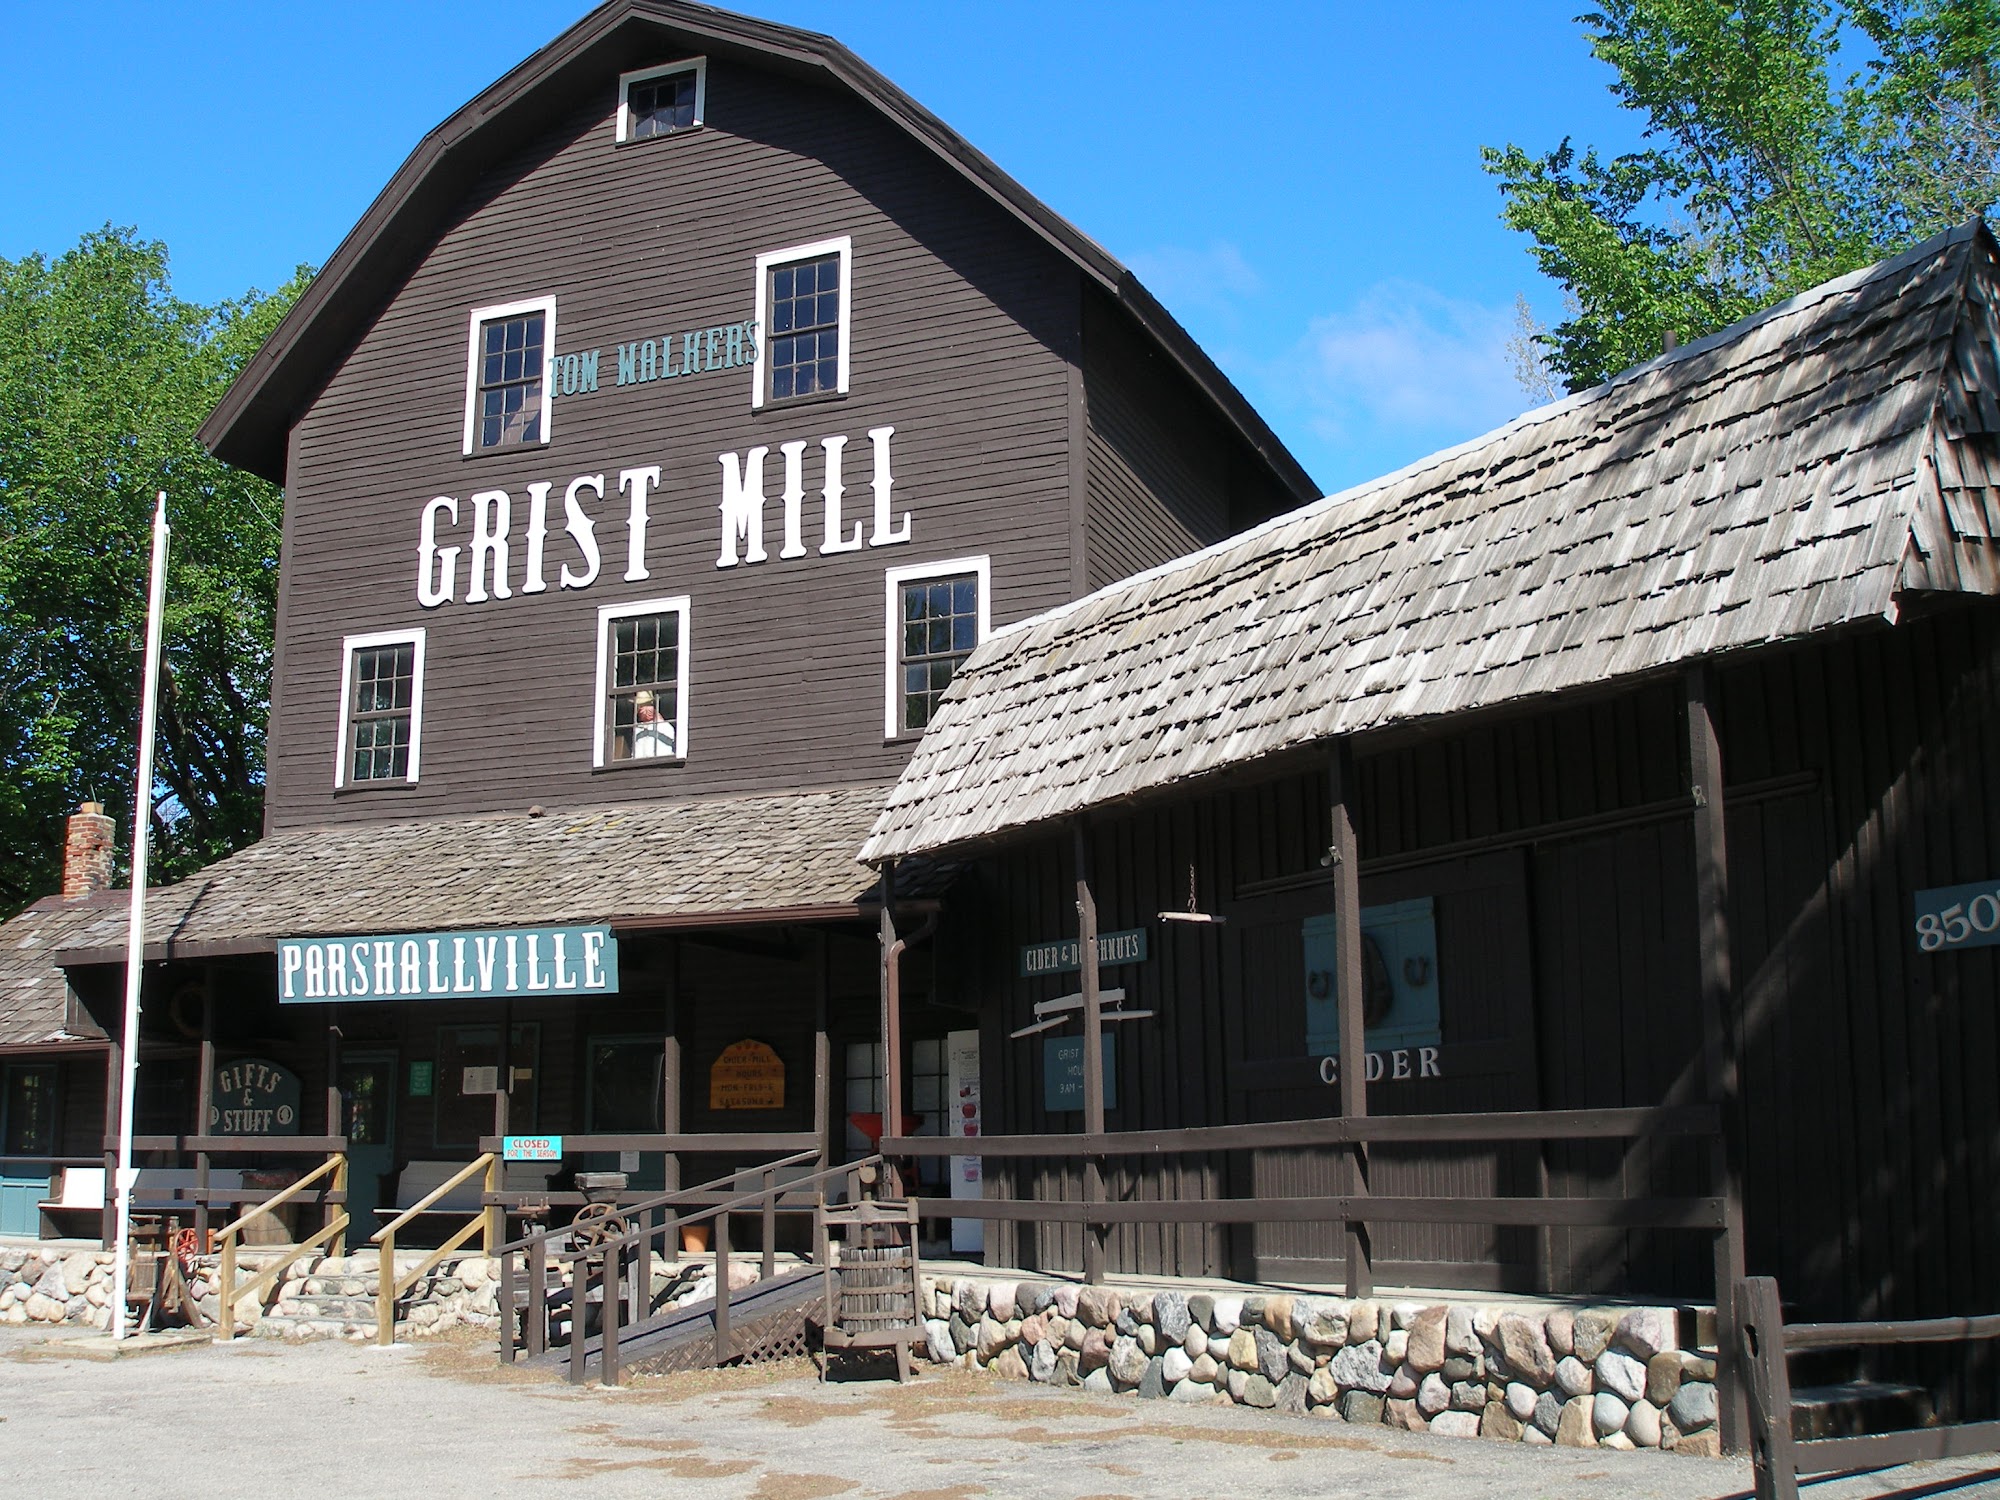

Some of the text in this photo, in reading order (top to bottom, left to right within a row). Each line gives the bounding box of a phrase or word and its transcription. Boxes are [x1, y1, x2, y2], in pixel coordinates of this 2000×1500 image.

[549, 350, 599, 397] TOM
[417, 426, 911, 607] GRIST MILL
[1916, 889, 2000, 951] 850
[282, 931, 606, 998] PARSHALLVILLE
[1026, 934, 1139, 971] CIDER & DHNUTS
[1058, 1048, 1080, 1060] GRIST
[1320, 1047, 1440, 1084] CDER
[221, 1064, 282, 1093] GIFTS
[1067, 1065, 1085, 1076] HOU
[243, 1088, 254, 1106] &
[223, 1109, 273, 1132] STUFF
[507, 1149, 557, 1158] FOR THE SEASON
[513, 1139, 550, 1148] CLOSED
